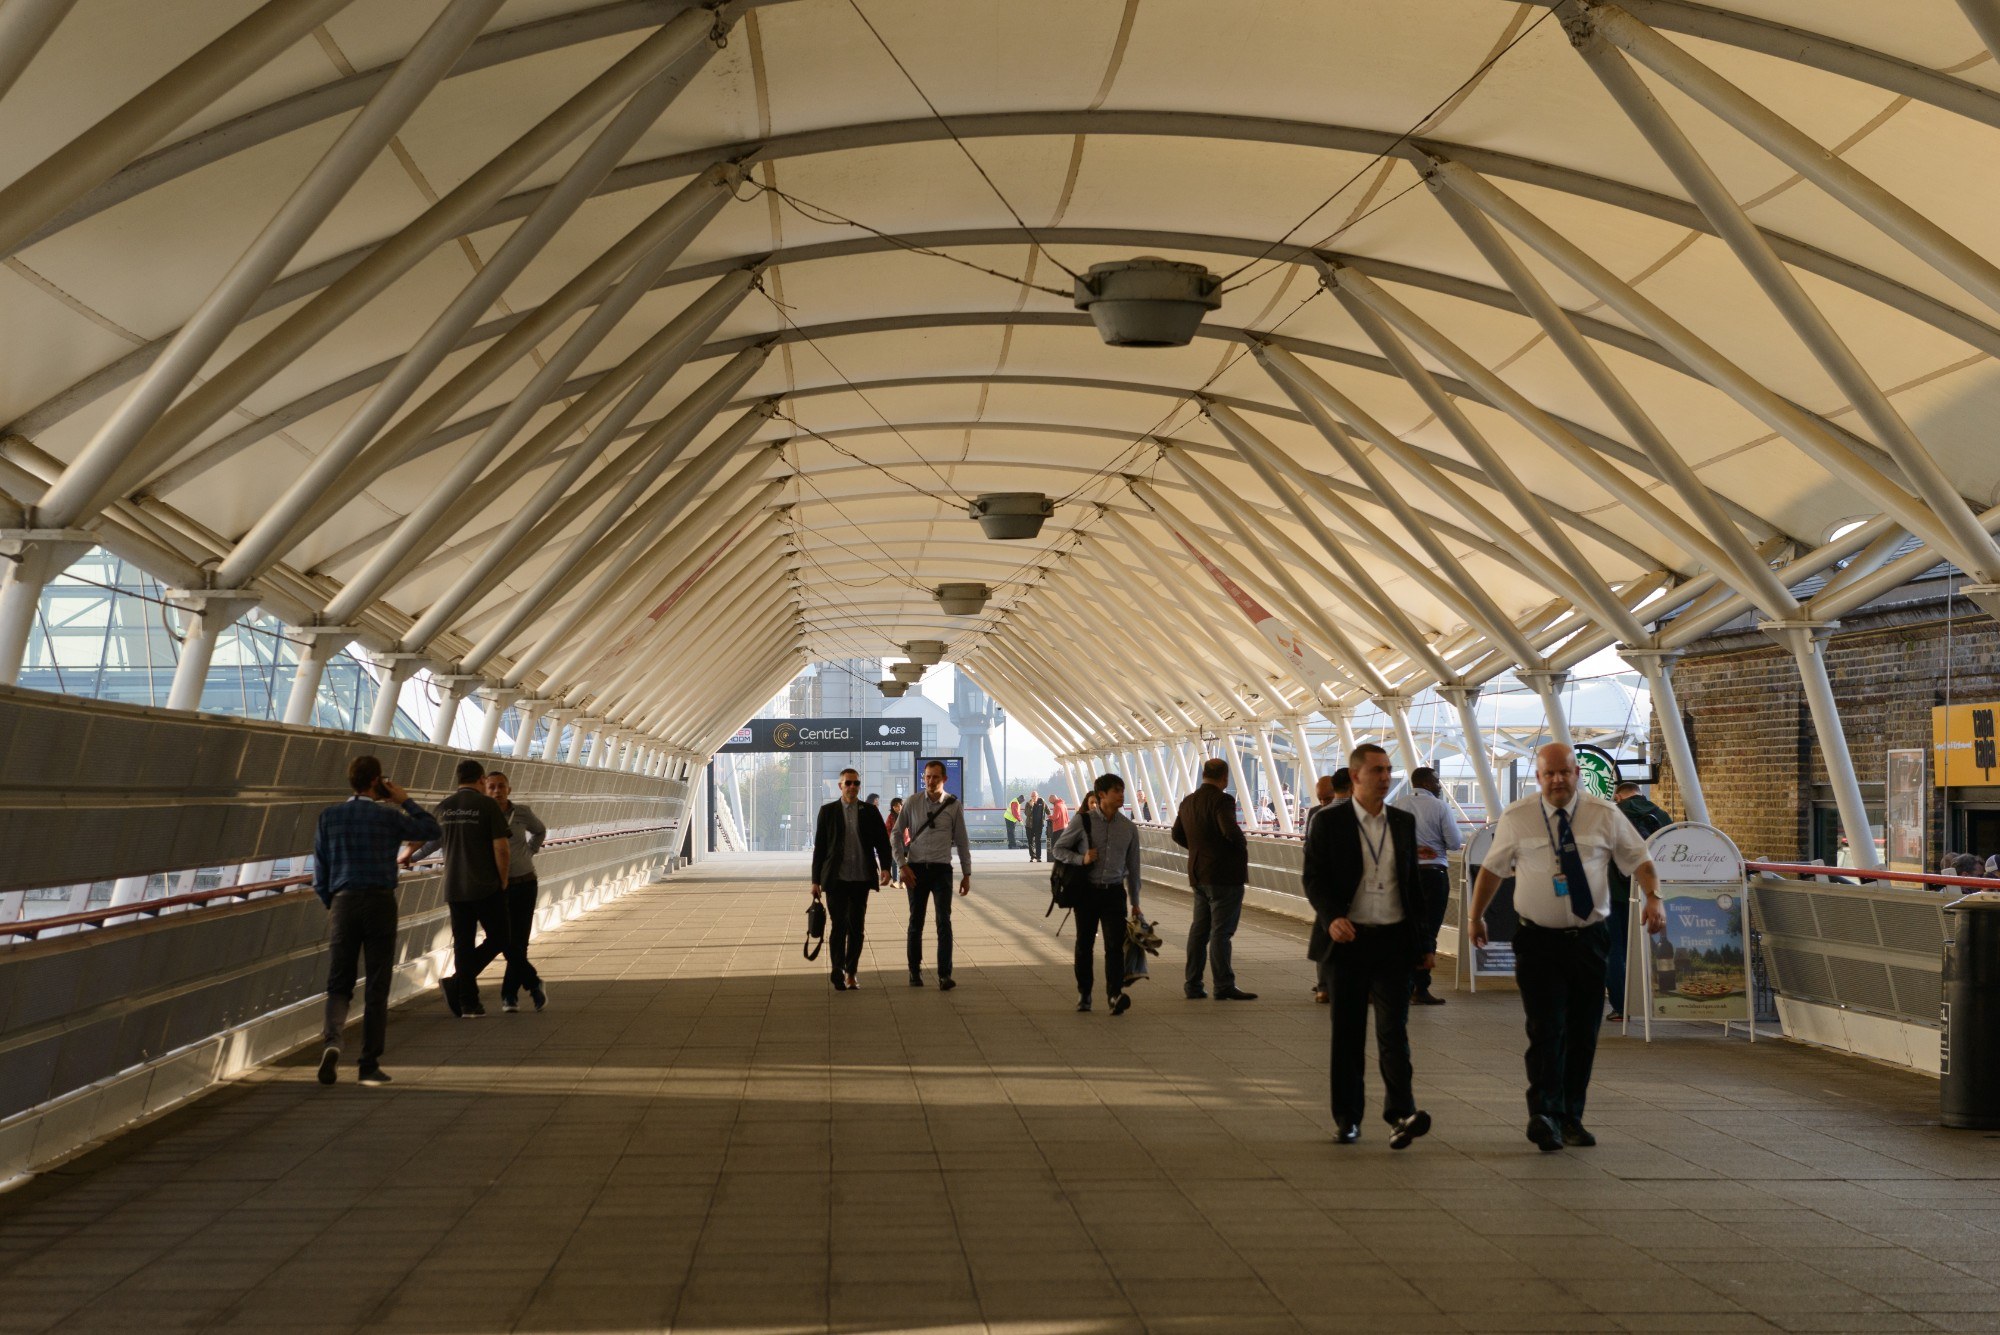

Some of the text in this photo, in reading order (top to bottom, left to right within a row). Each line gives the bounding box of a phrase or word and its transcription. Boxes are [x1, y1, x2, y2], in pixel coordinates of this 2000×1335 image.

[799, 728, 849, 740] CentrEd
[889, 726, 906, 735] GES
[1654, 844, 1727, 874] la Barrique
[1669, 903, 1692, 913] Enjoy
[1678, 914, 1717, 928] Wine
[1680, 935, 1713, 947] Finest
